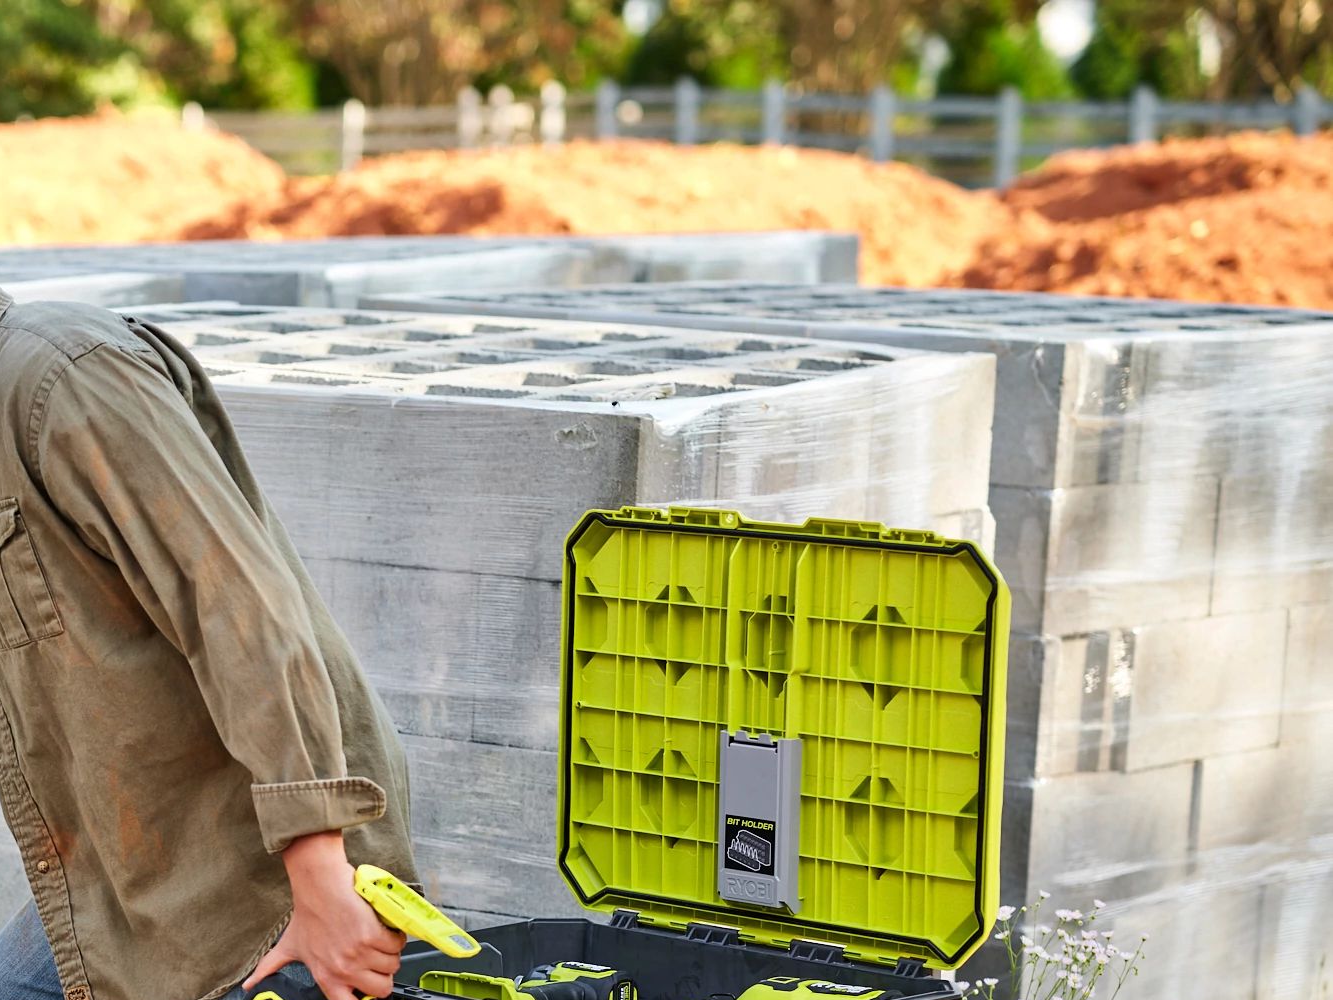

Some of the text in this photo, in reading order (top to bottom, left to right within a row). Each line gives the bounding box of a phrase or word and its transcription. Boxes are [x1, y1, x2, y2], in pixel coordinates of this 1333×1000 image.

[727, 818, 774, 831] BIT HOLDER
[726, 877, 771, 900] RYOBI
